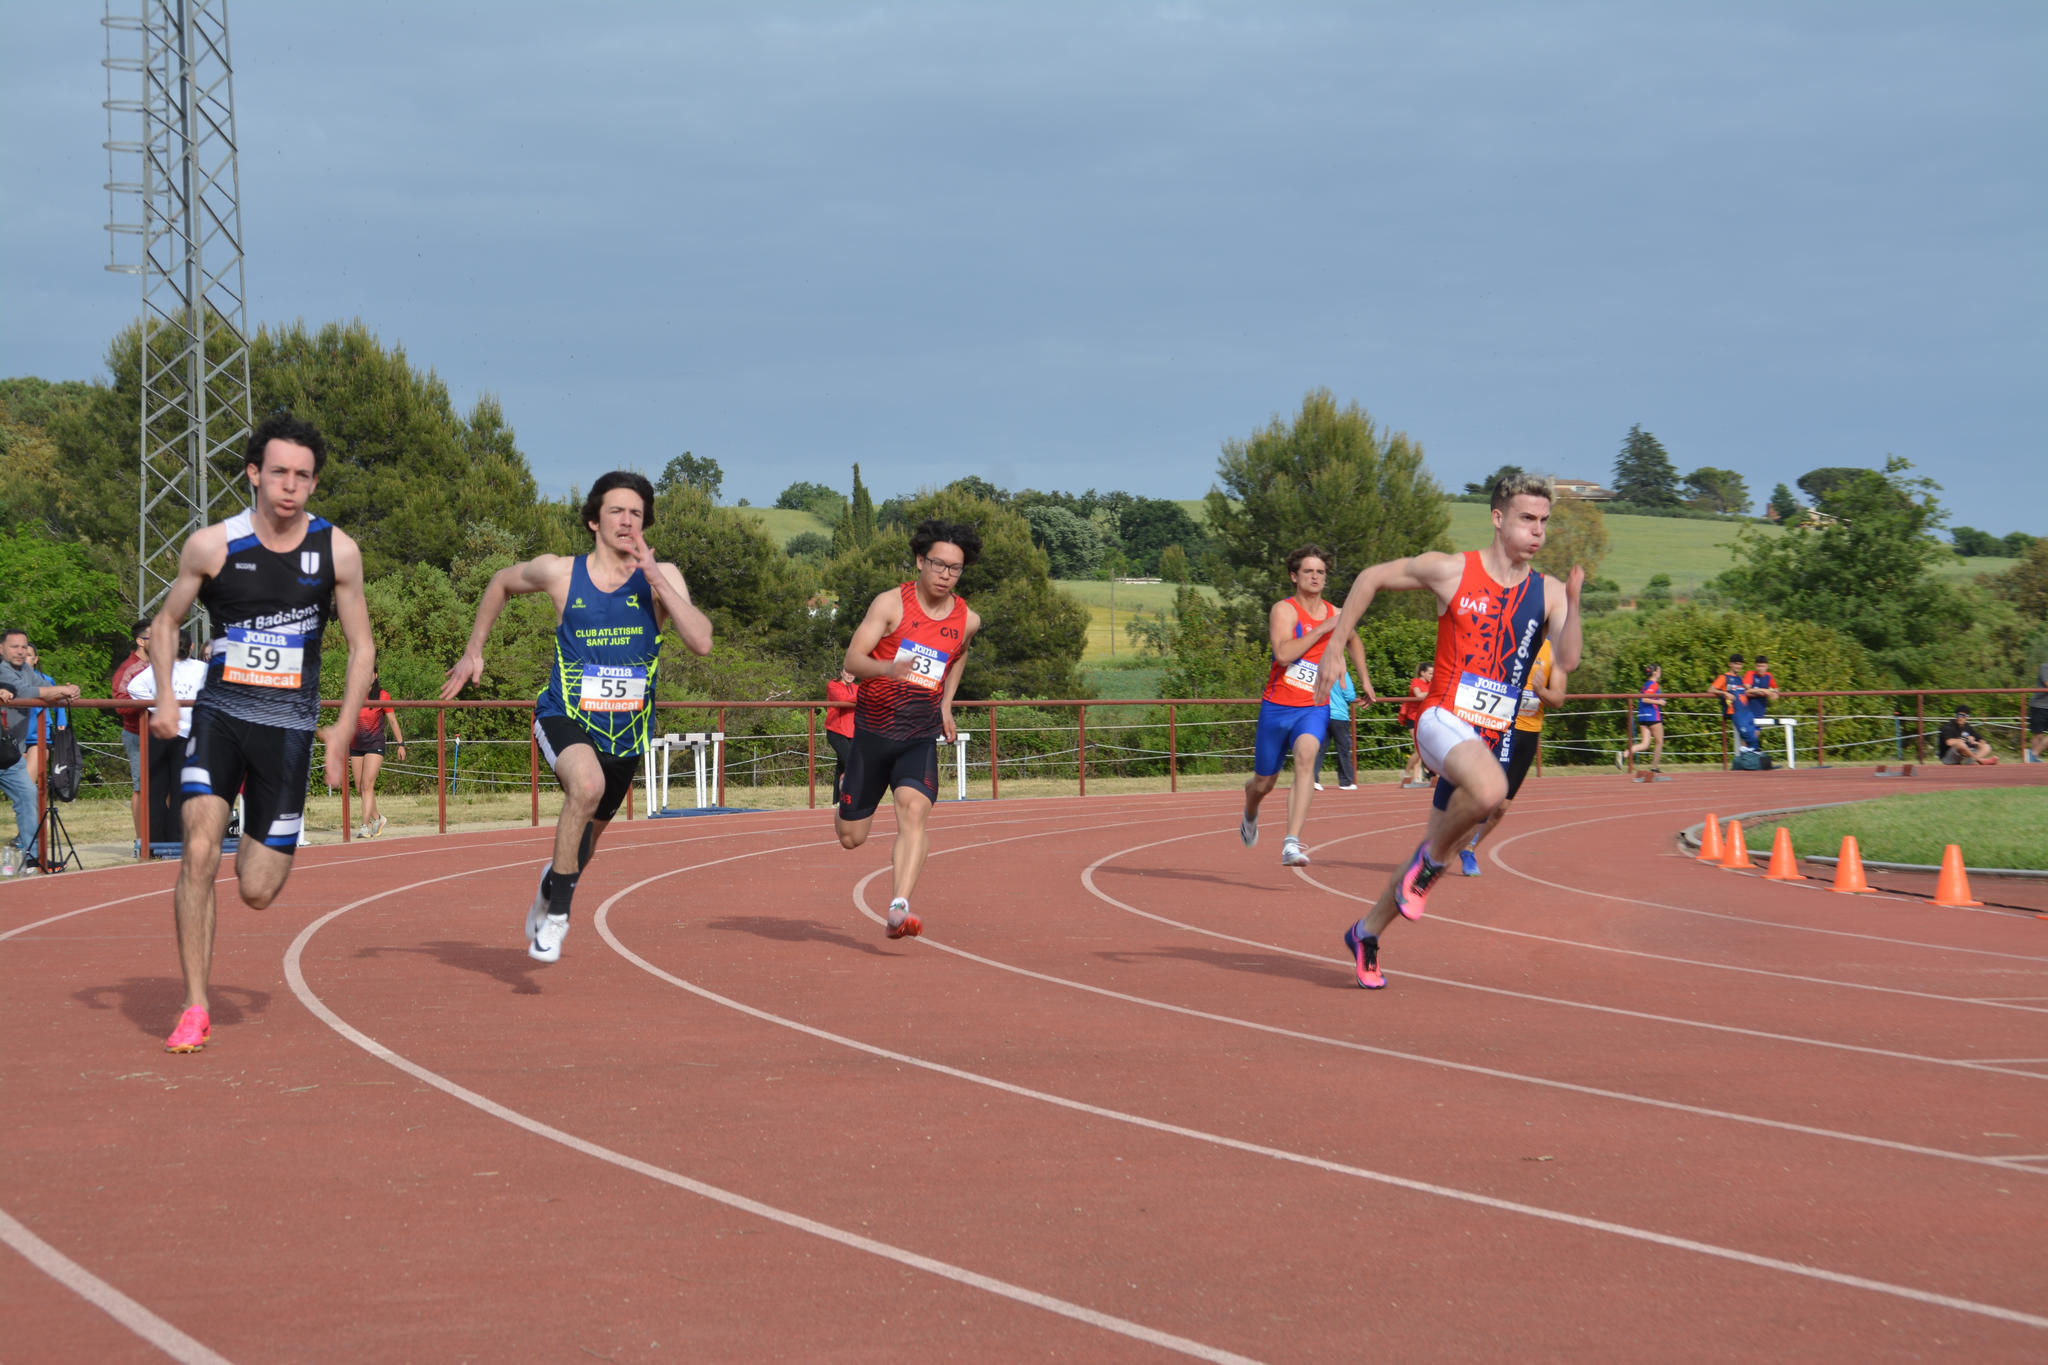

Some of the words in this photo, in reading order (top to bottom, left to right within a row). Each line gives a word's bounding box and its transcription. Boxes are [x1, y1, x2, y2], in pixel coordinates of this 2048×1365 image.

[243, 630, 288, 646] Joma
[575, 629, 597, 638] CLUB
[598, 626, 644, 637] ATLETISME
[586, 638, 608, 647] SANT
[609, 637, 631, 646] JUST
[246, 646, 280, 671] 59
[911, 643, 938, 659] Joma
[597, 666, 633, 678] Joma
[910, 655, 932, 675] 63
[227, 669, 295, 686] mutuacat
[1296, 667, 1315, 683] 53
[599, 679, 628, 698] 55
[1474, 677, 1508, 695] Joma
[584, 700, 639, 711] mutuacat
[1472, 690, 1502, 714] 57
[1456, 708, 1509, 731] mutuacat
